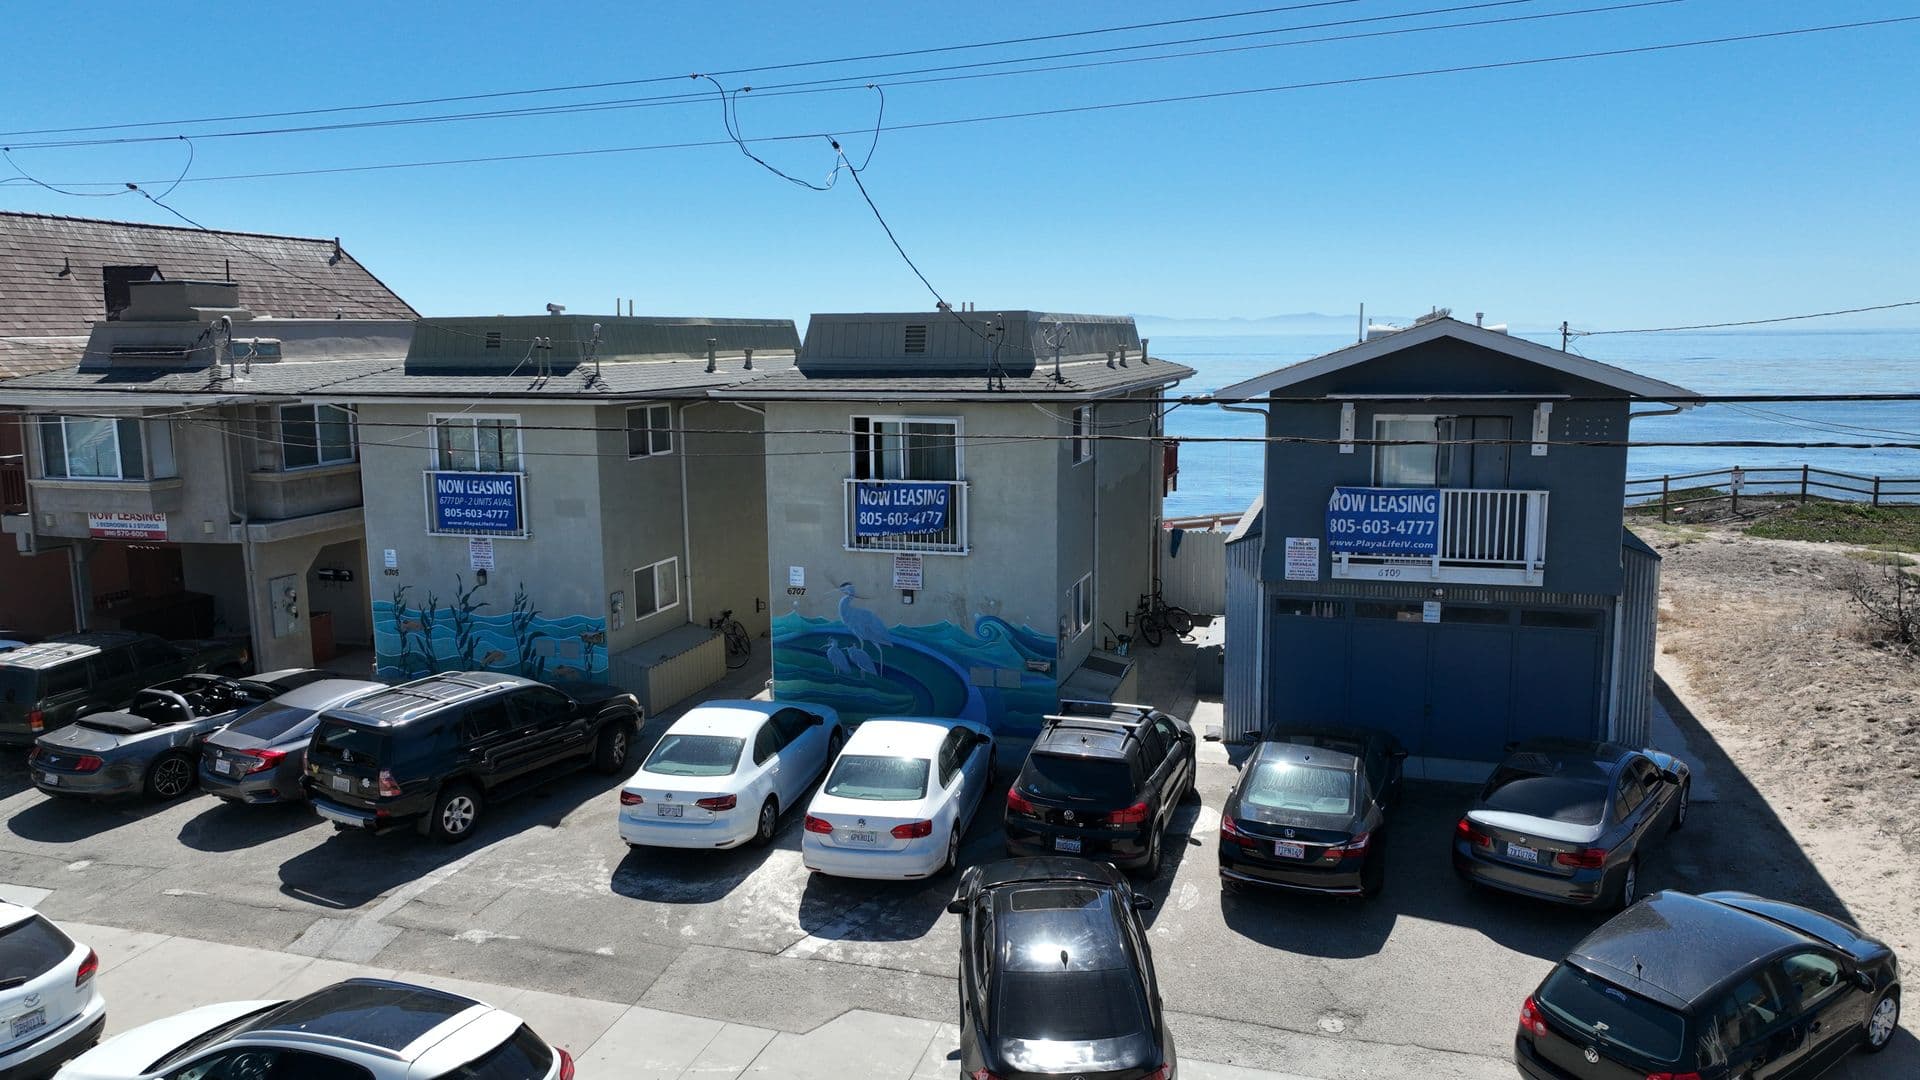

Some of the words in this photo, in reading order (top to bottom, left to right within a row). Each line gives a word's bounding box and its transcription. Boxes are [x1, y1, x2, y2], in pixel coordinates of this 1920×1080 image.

[438, 479, 464, 494] NOW
[466, 480, 512, 495] LEASING
[473, 497, 492, 506] UNITS
[860, 488, 890, 506] NOW
[893, 488, 946, 506] LEASING
[1329, 493, 1367, 512] NOW
[1370, 494, 1436, 513] LEASING
[89, 512, 113, 520] NOW
[117, 512, 165, 522] LEASING!
[444, 508, 509, 519] 805-603-4777
[859, 511, 943, 525] 805-603-4777
[1330, 518, 1435, 535] 805-603-4777
[1330, 540, 1433, 549] www.PlayaLifeIV.com
